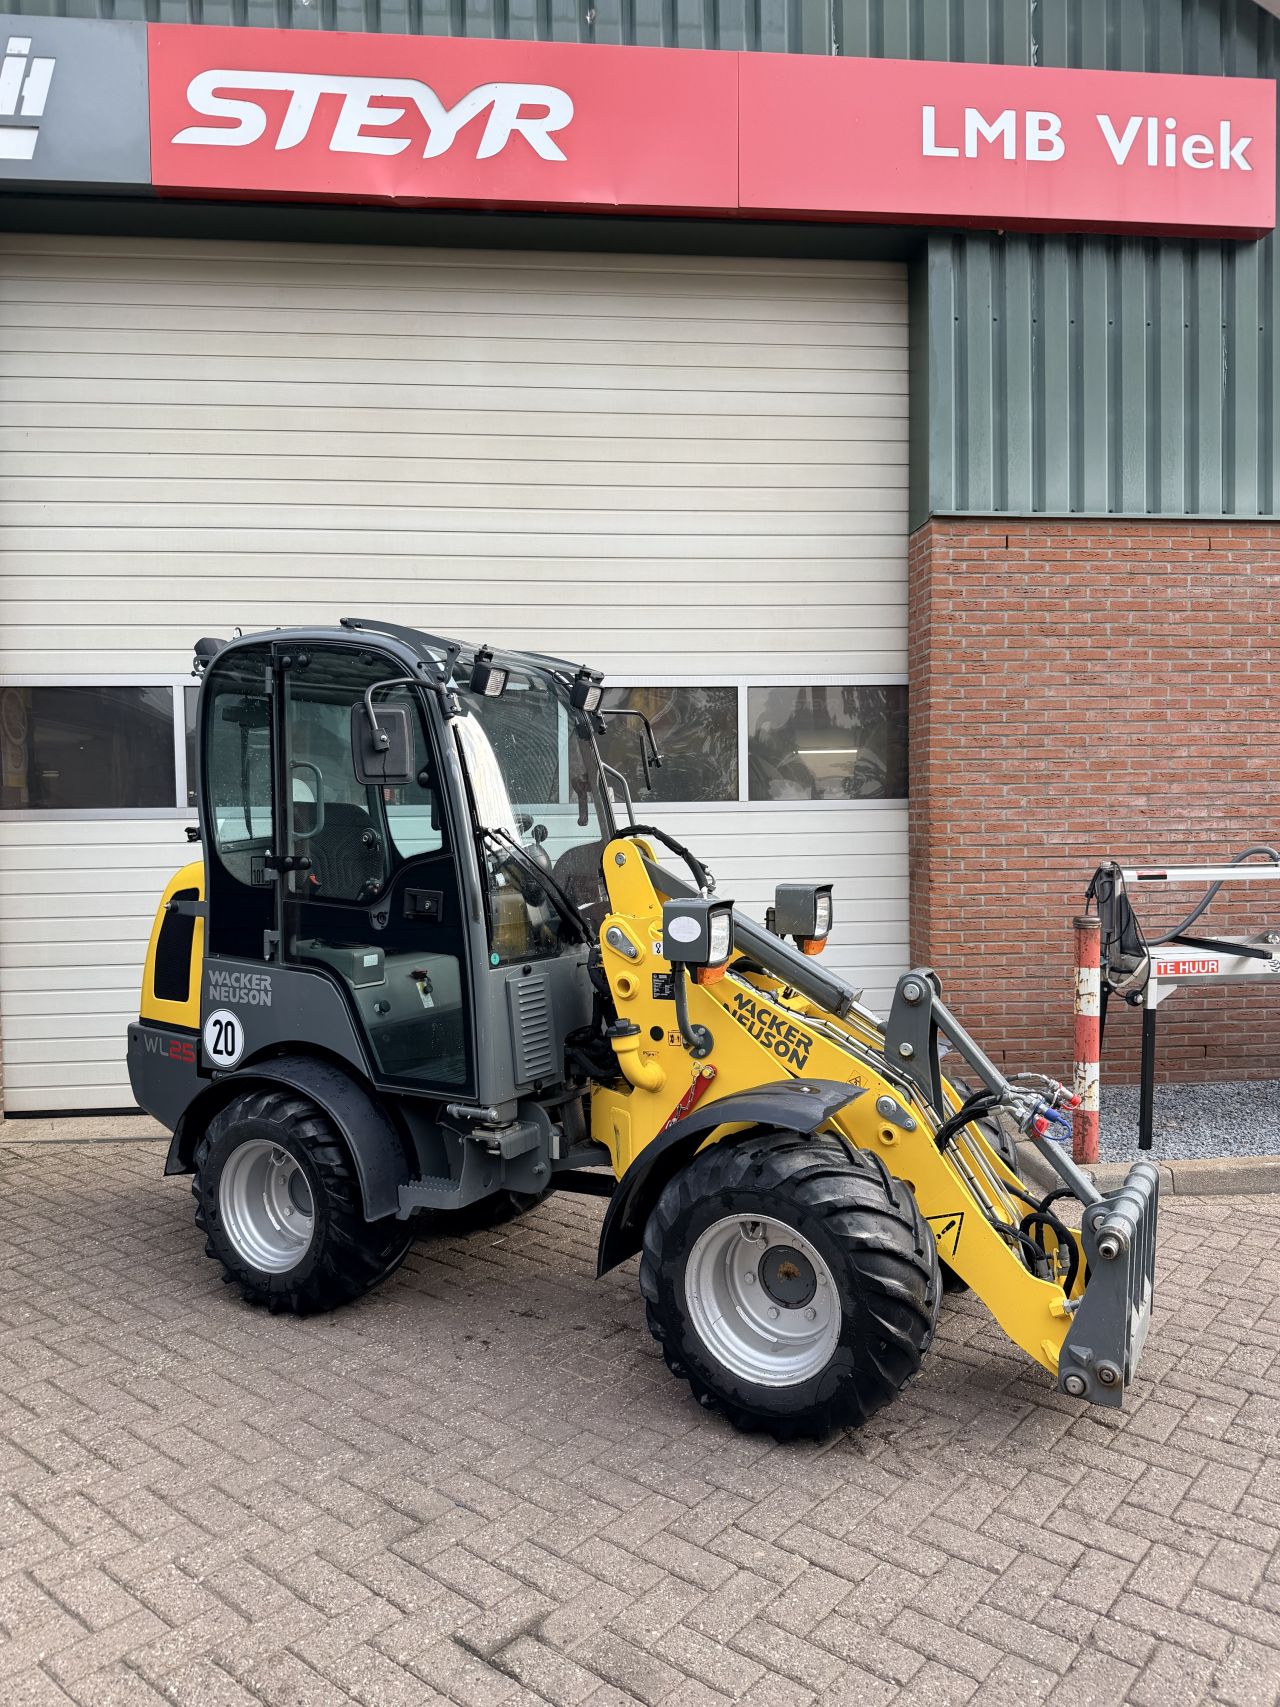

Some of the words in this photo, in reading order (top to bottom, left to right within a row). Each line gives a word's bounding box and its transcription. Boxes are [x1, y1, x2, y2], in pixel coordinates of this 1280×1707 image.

[171, 69, 575, 162] STEYR
[921, 105, 1066, 162] LMB
[1096, 114, 1253, 171] Vliek
[208, 969, 272, 991] WACKER
[1158, 962, 1175, 974] TE
[1180, 960, 1218, 974] HUUR
[209, 985, 272, 1007] NEUSON
[143, 1033, 196, 1063] WL25
[212, 1019, 235, 1057] 20
